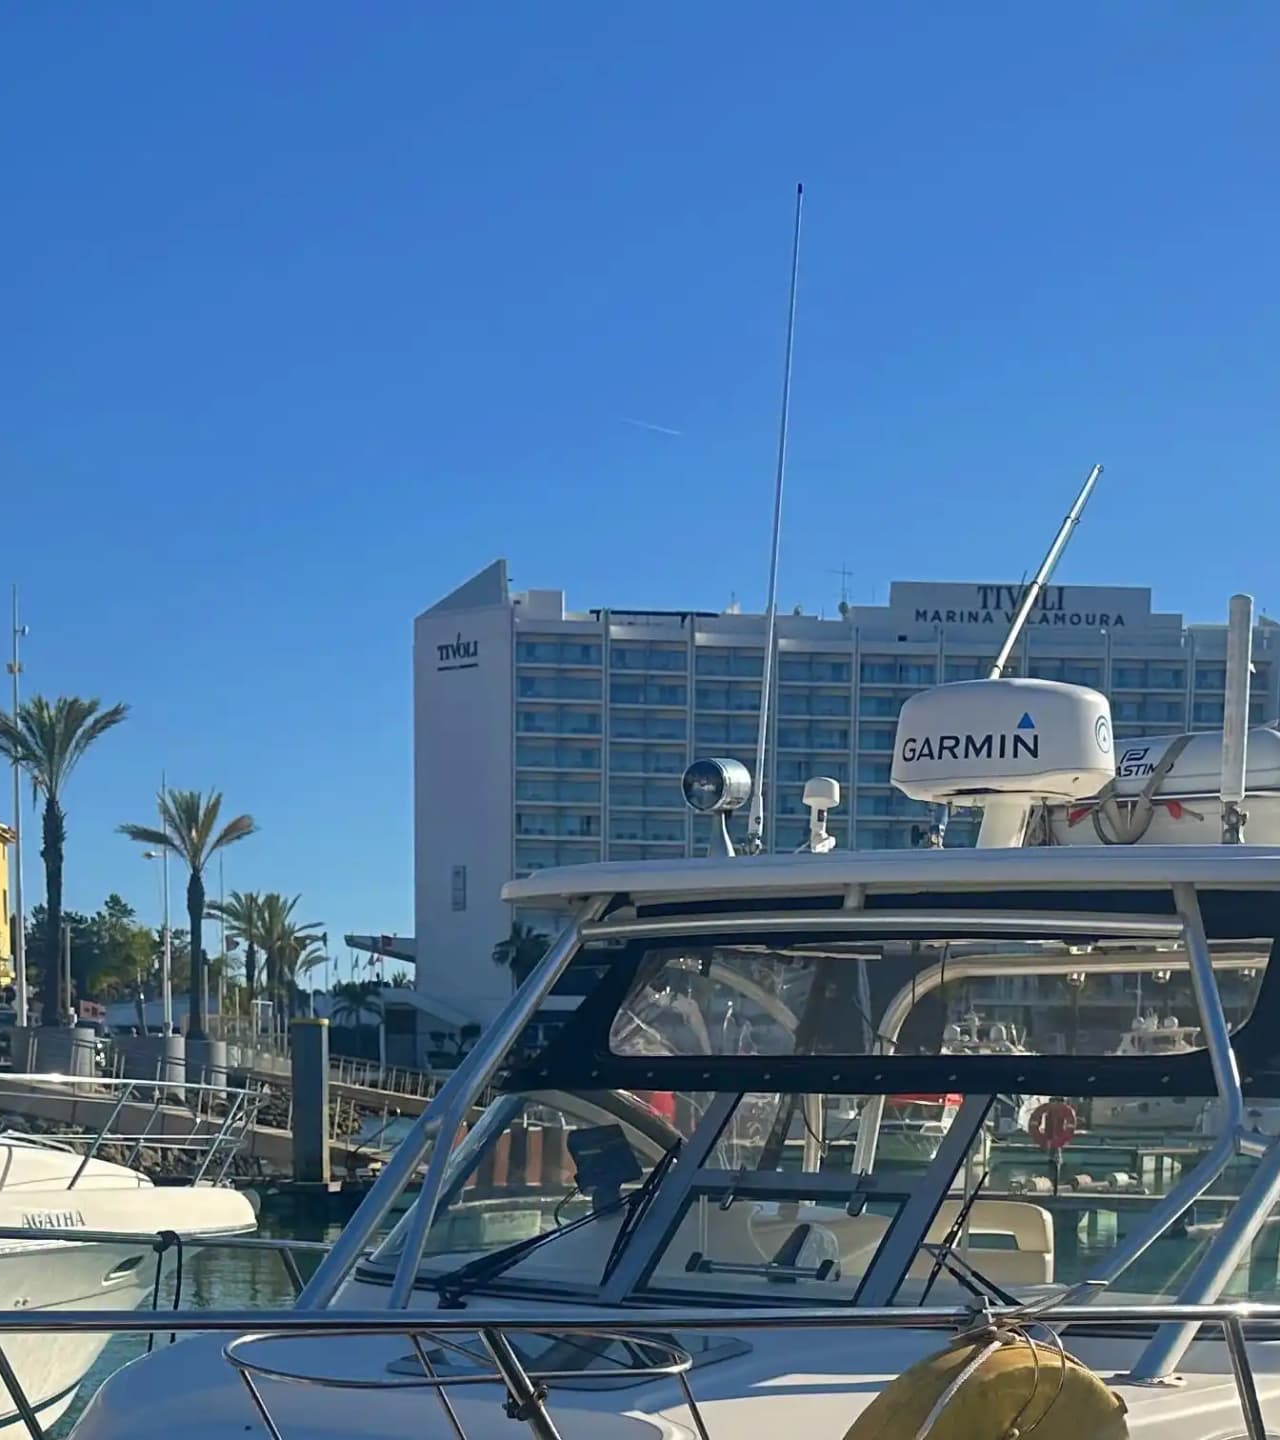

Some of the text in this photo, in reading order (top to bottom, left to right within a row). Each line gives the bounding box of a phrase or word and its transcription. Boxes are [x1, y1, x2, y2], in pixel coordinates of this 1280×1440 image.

[915, 608, 1125, 627] MARINA VLAMOURA
[437, 632, 478, 660] TIVOLI
[902, 734, 1039, 762] GARMIN
[22, 1209, 86, 1228] AGATHA
